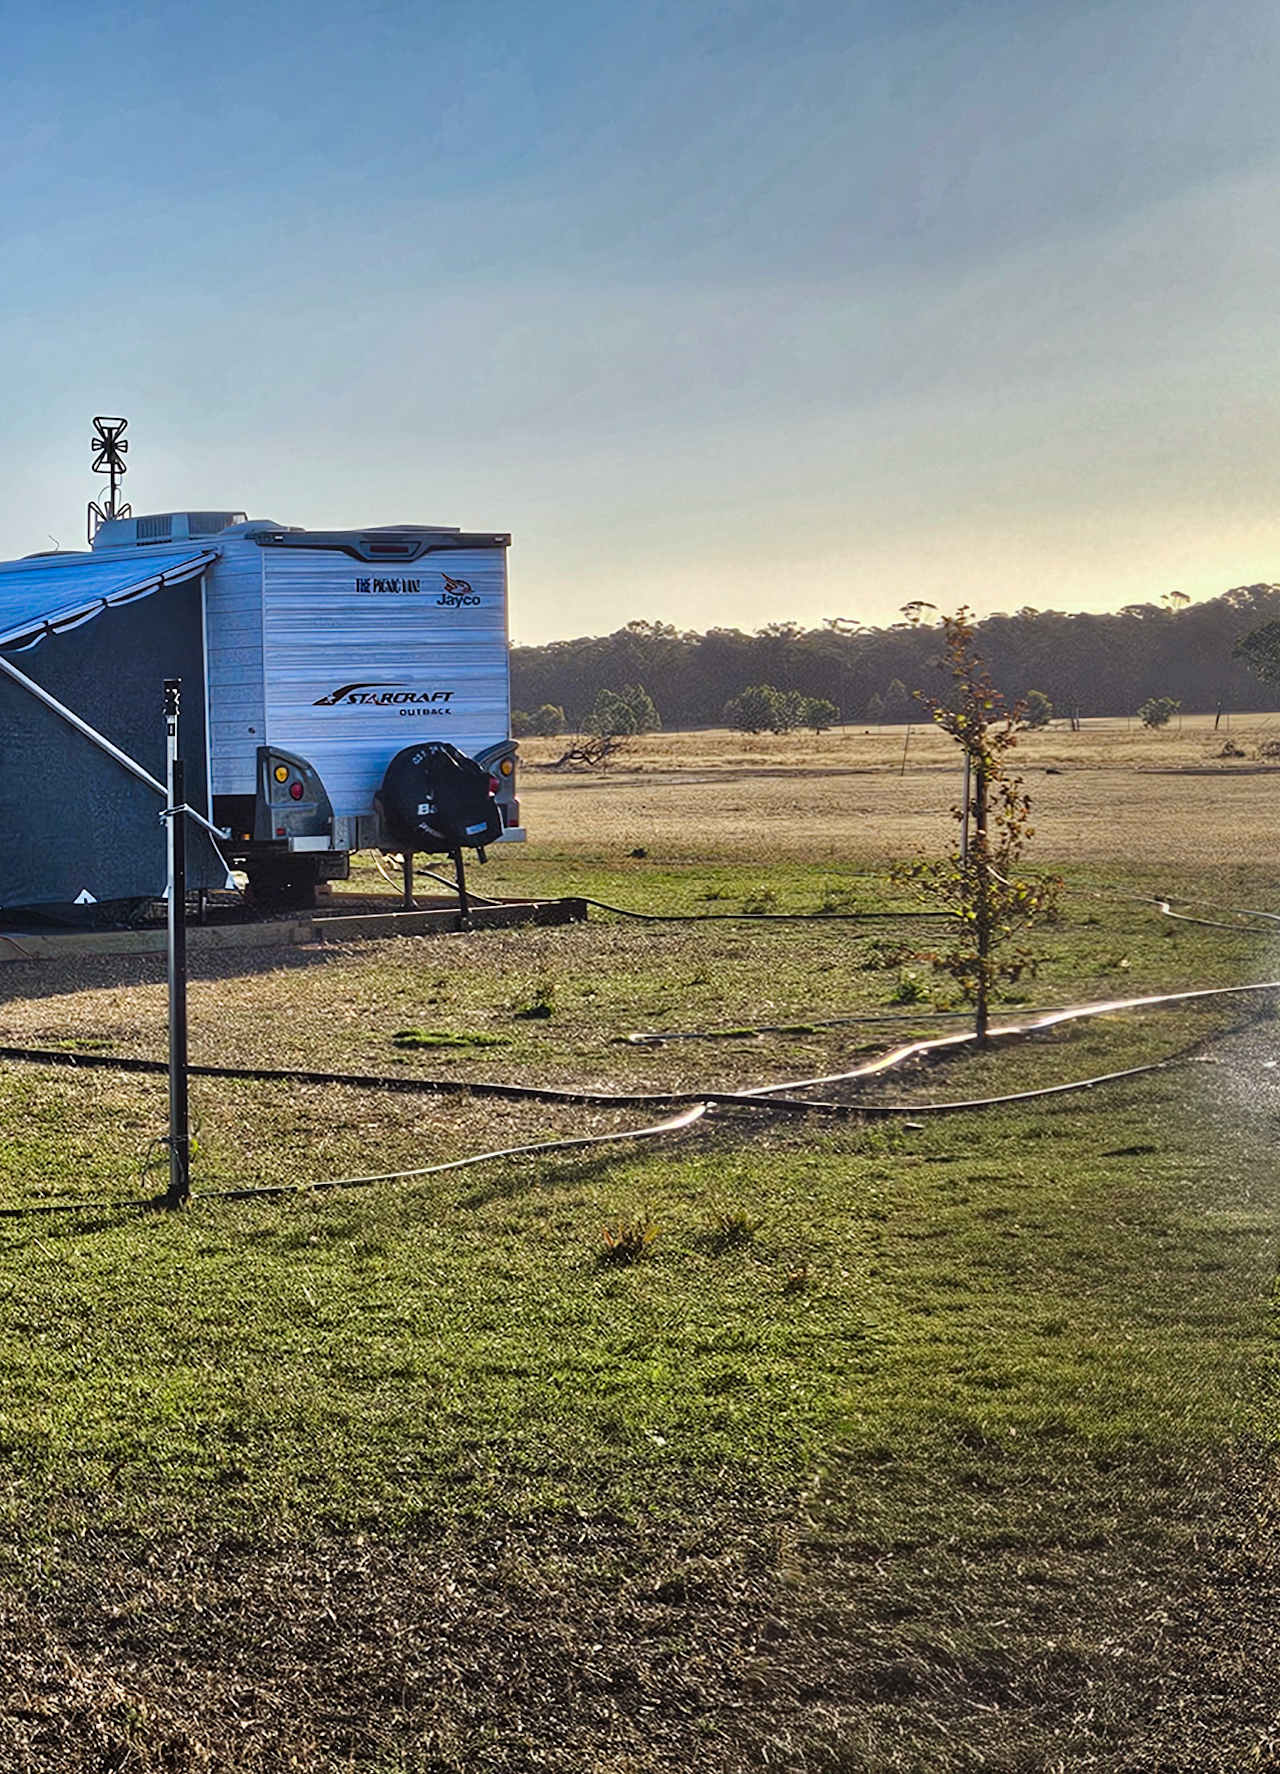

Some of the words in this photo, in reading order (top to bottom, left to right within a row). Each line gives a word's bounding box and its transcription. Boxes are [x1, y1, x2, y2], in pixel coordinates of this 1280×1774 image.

[356, 577, 371, 593] THE
[436, 593, 481, 608] Jayco
[347, 691, 456, 706] STARCRAFT
[399, 708, 452, 717] OUTBACK
